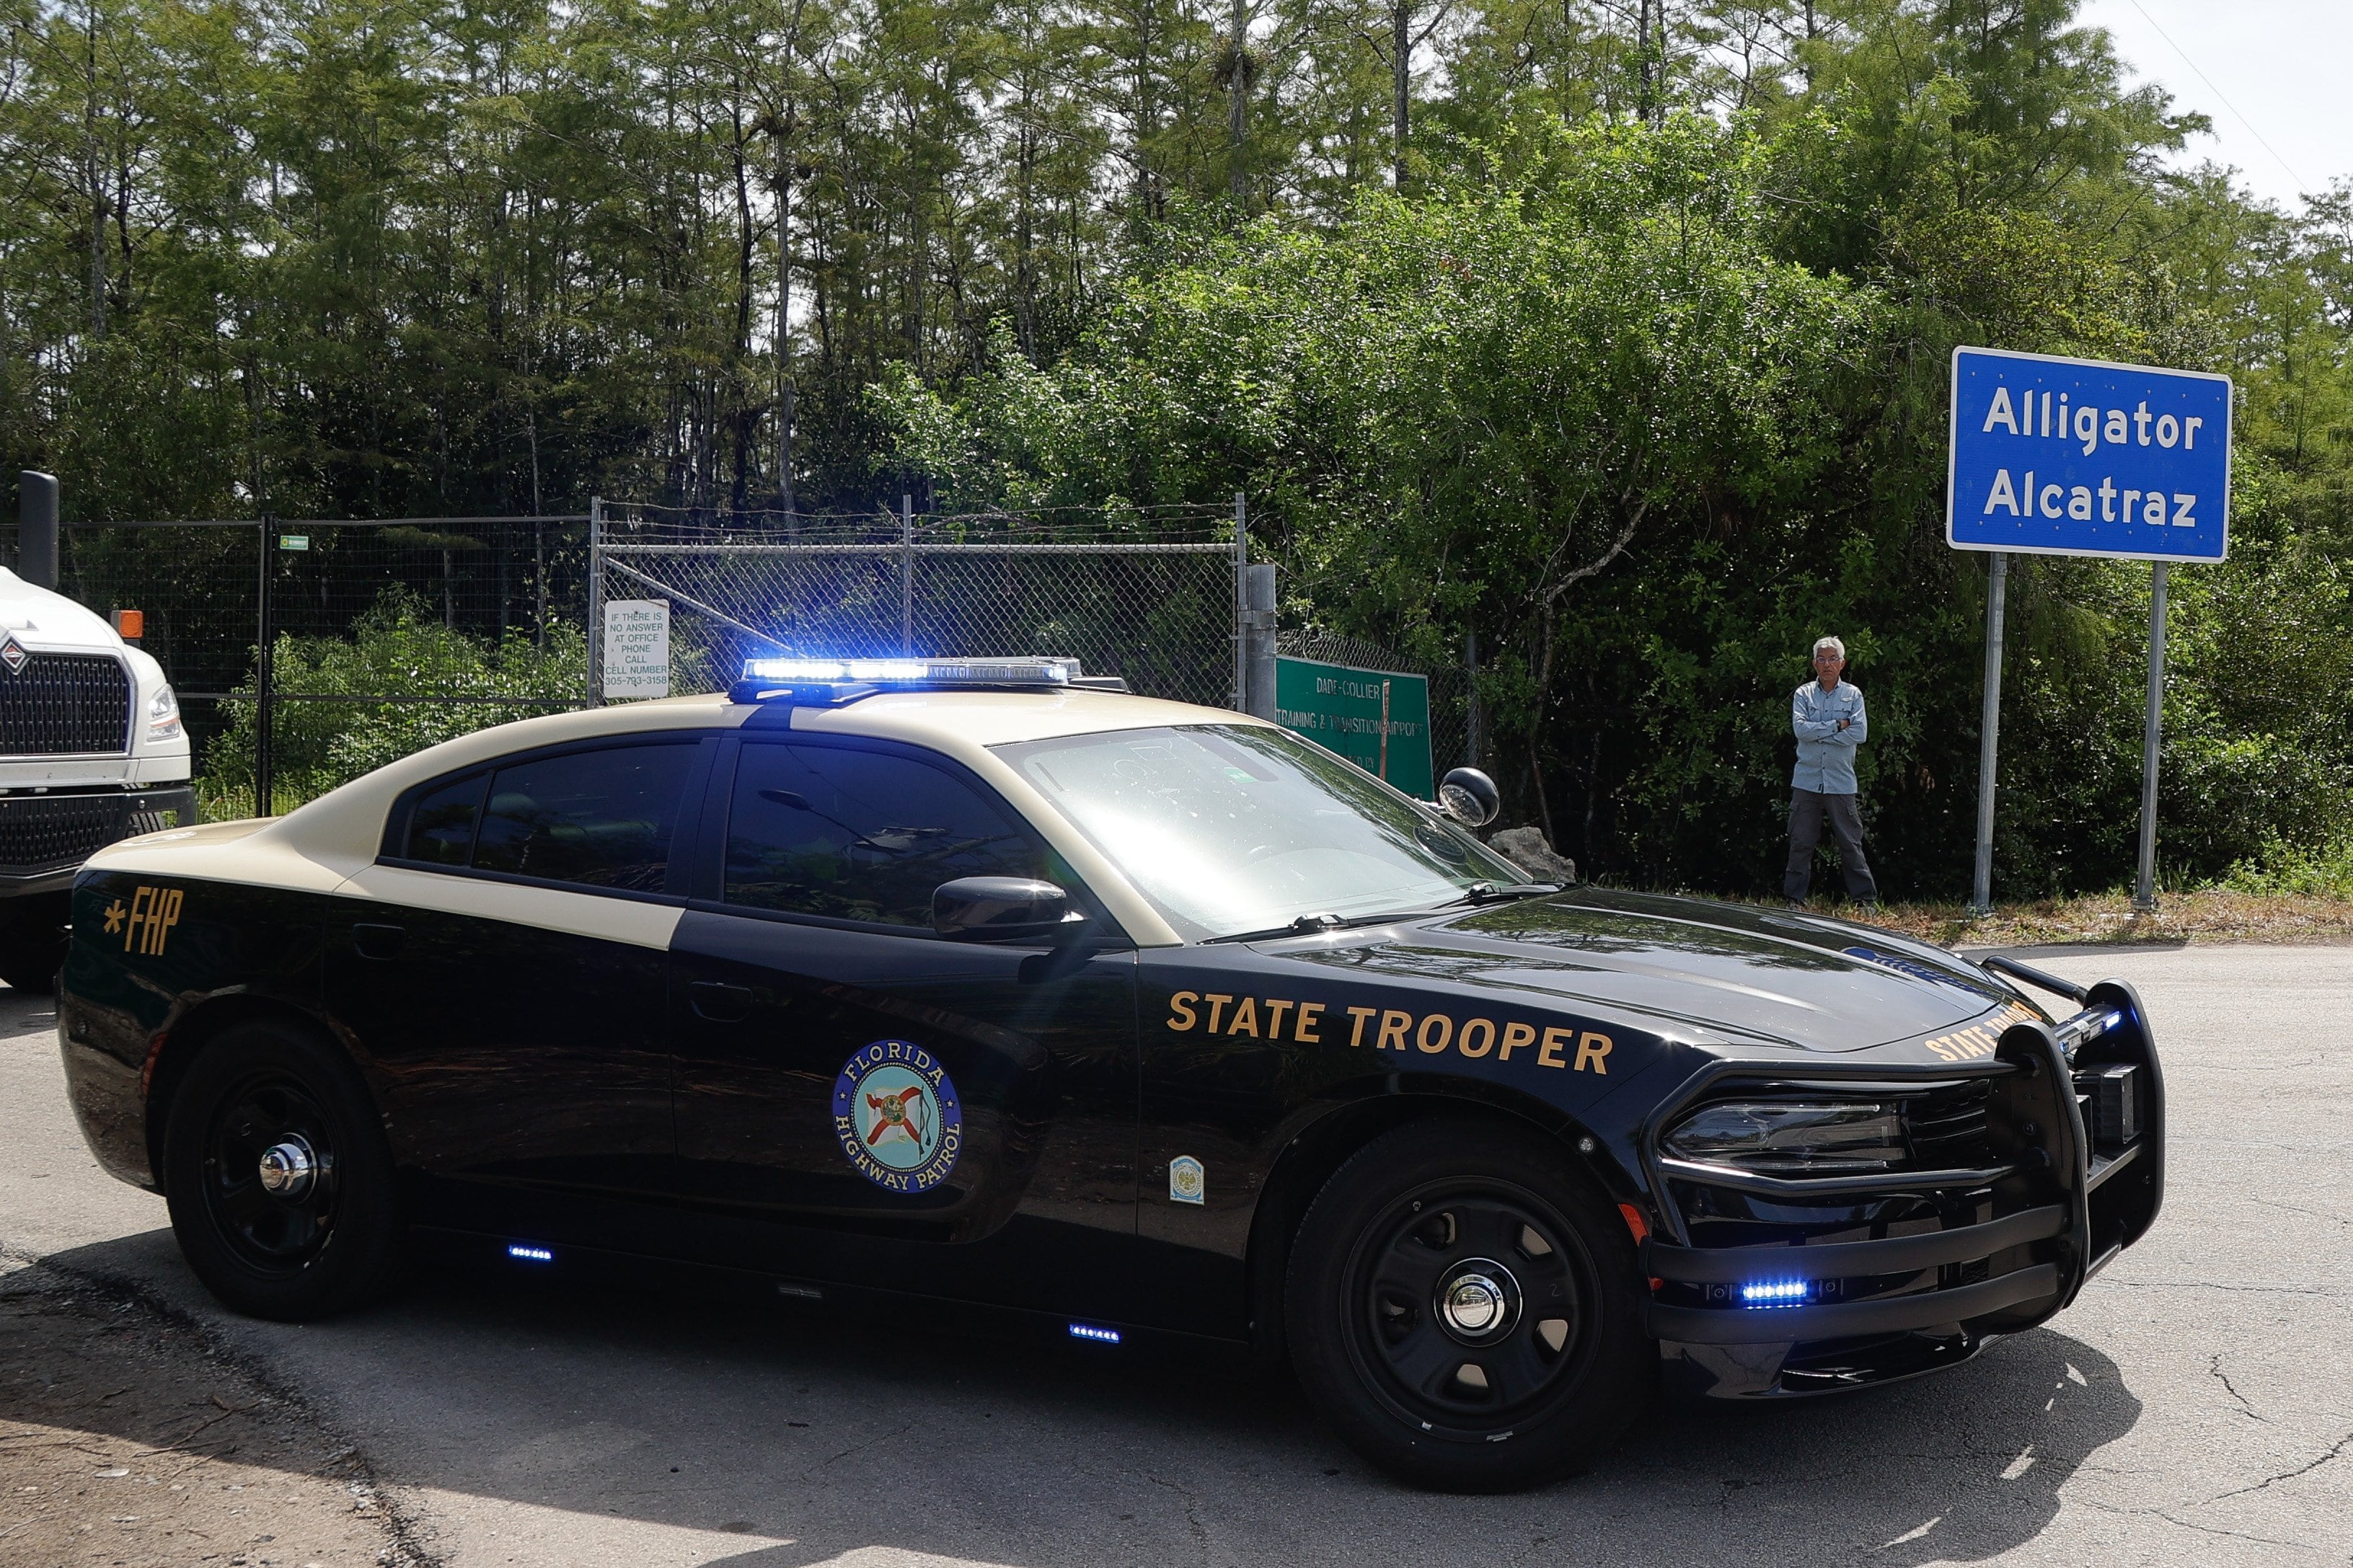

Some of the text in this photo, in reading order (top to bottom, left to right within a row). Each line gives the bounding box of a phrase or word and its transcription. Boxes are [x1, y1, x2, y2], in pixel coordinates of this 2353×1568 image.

[1982, 386, 2203, 457] Alligator
[1983, 469, 2197, 528] Alcatraz
[622, 613, 650, 621] THERE
[653, 612, 662, 621] IS
[626, 623, 663, 632] ANSWER
[628, 634, 658, 642] OFFICE
[605, 665, 667, 675] CELL NUMBER
[625, 655, 647, 664] CALL
[605, 676, 667, 685] 305-793-3158
[1276, 708, 1316, 729] TRAINING
[1166, 991, 1613, 1075] STATE TROOPER
[1925, 1026, 1997, 1061] STATE
[844, 1042, 945, 1086] FLORIDA
[836, 1116, 960, 1190] HIGHWAY PATROL
